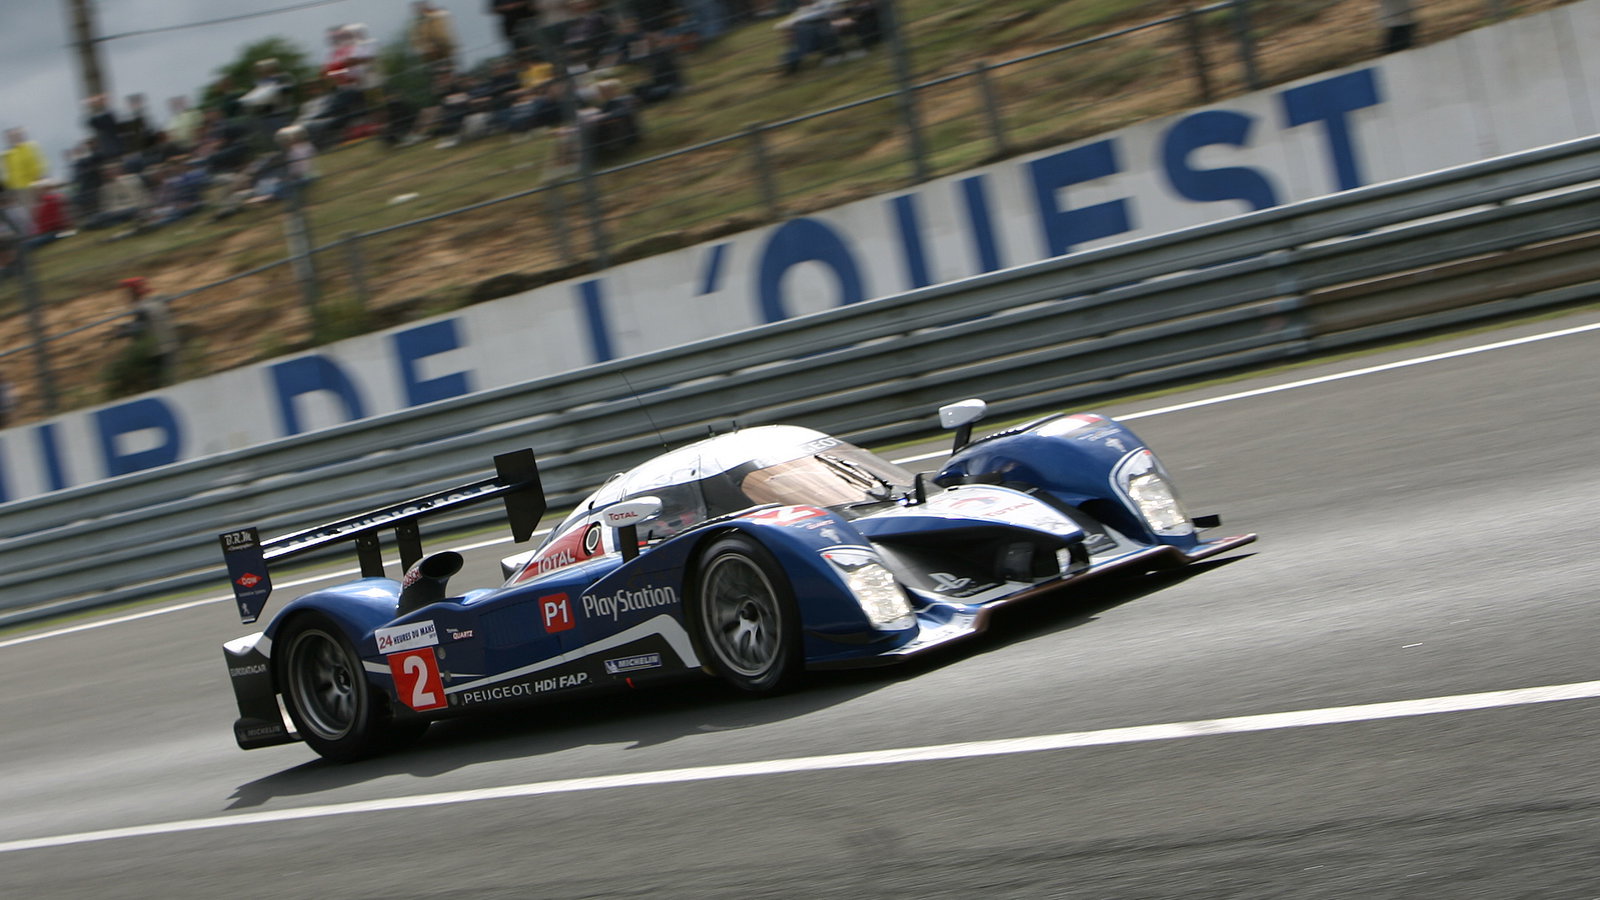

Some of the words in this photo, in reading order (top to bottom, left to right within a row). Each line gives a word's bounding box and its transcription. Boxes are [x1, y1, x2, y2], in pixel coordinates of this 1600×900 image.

[545, 599, 569, 627] P1
[583, 585, 677, 621] PlayStation
[379, 635, 393, 650] 24
[393, 631, 411, 645] HEURES
[411, 629, 420, 637] DU
[420, 624, 434, 634] MANS
[404, 656, 436, 707] 2
[463, 683, 530, 704] PEUGEOT
[559, 672, 588, 687] FAP
